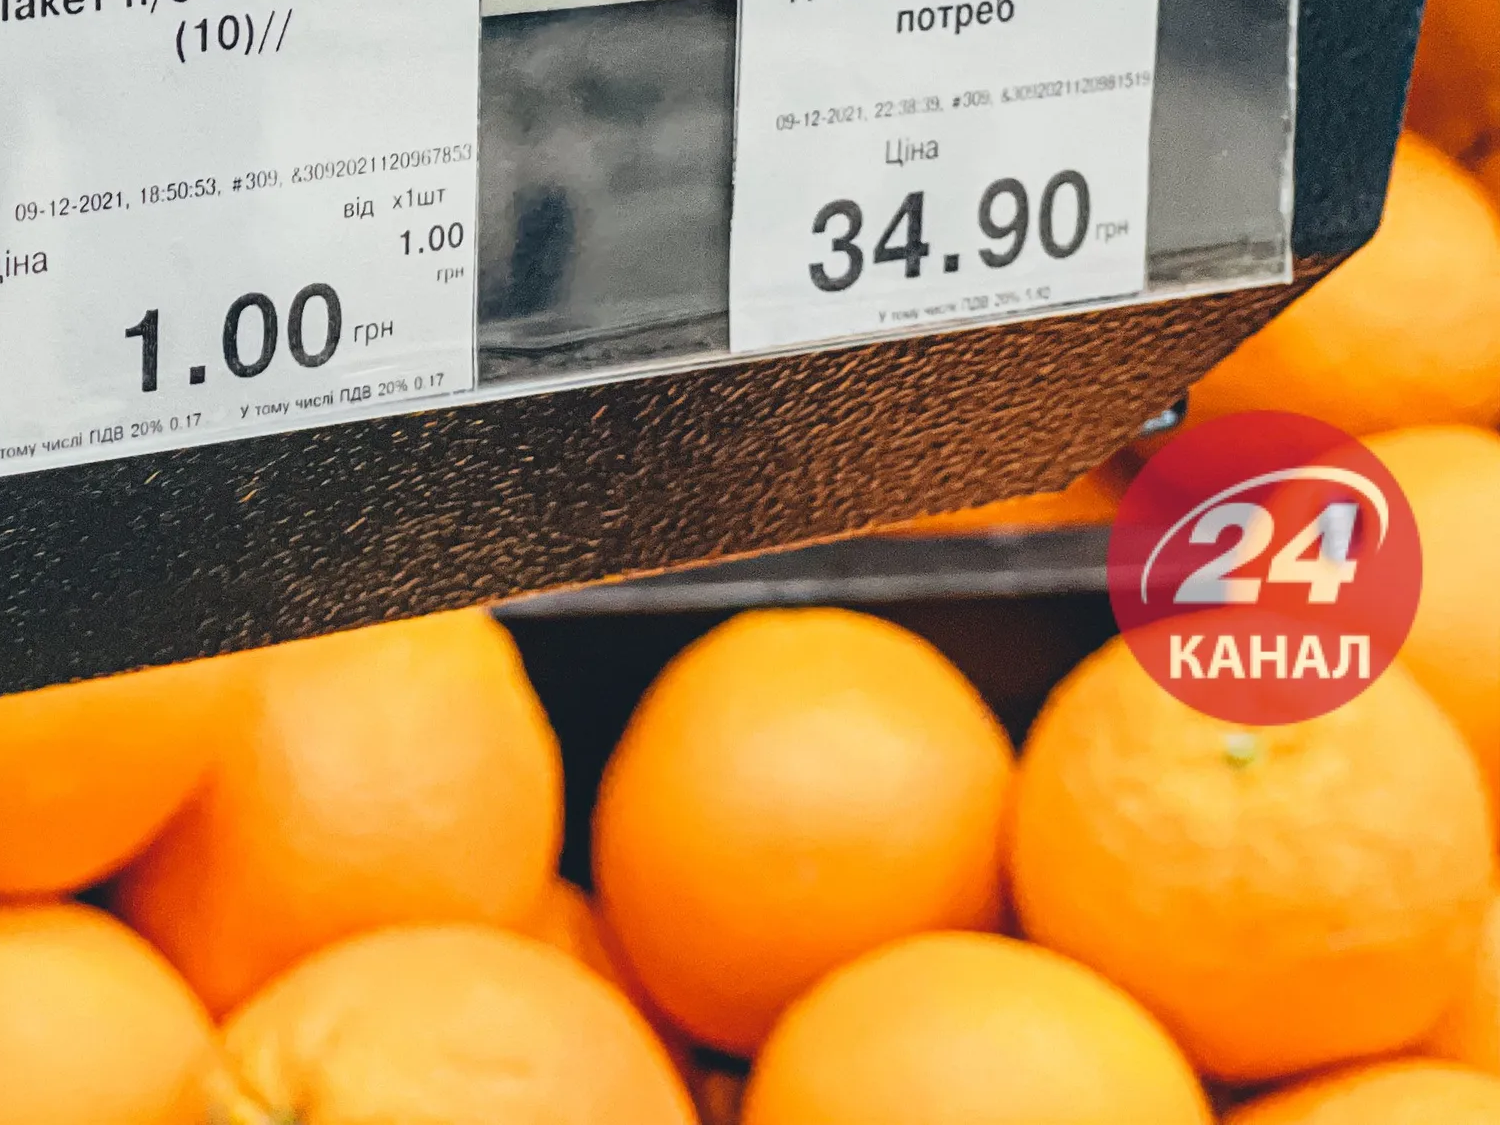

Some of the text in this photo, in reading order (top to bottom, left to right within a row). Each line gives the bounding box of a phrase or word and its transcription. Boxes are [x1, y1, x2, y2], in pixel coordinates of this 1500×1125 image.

[175, 9, 293, 62] (10)//
[776, 105, 868, 131] 09-12-2021,
[885, 138, 939, 166] Ціна
[15, 143, 472, 223] 09-12-2021, 18:50:53, #309, &3092021120967853
[343, 198, 374, 219] від
[807, 169, 1129, 293] 34.90 грн
[400, 222, 464, 257] 1.00
[436, 266, 464, 284] грн
[125, 282, 394, 393] 1.00 грн
[240, 373, 444, 419] У тому числі ПДВ 20% 0.17
[0, 444, 36, 459] тому
[42, 432, 82, 452] числі
[90, 426, 123, 444] ПДВ
[131, 420, 163, 438] 20%
[170, 413, 201, 430] 0.17
